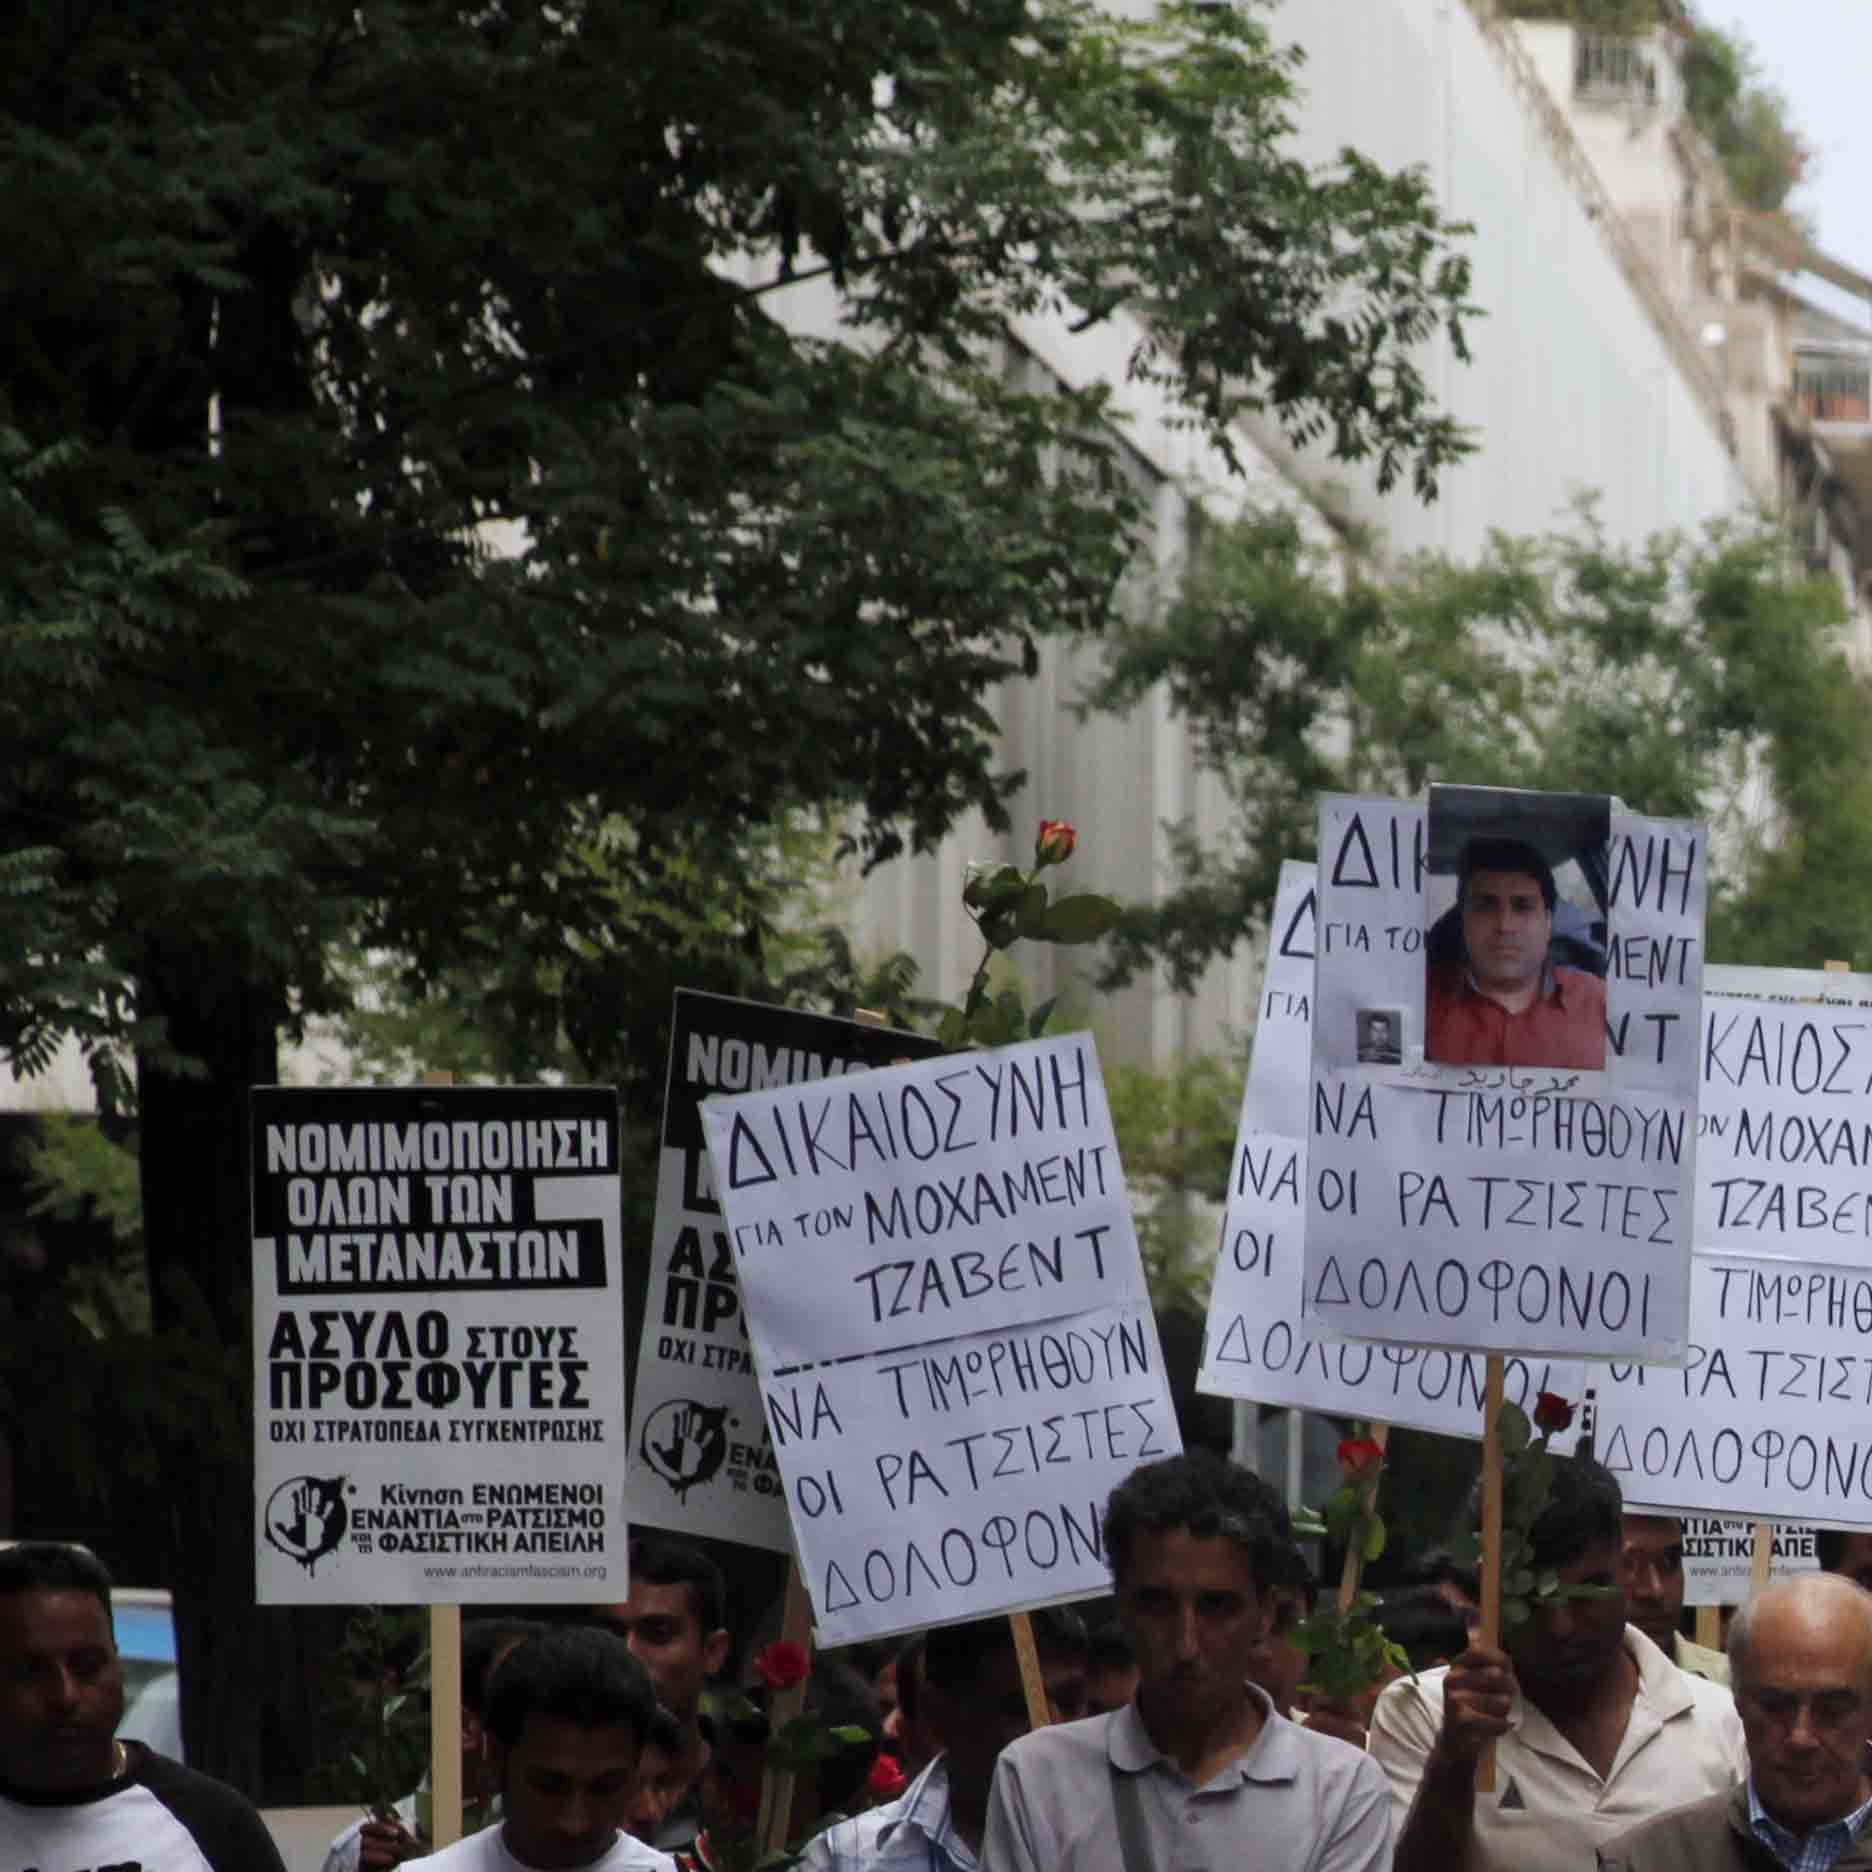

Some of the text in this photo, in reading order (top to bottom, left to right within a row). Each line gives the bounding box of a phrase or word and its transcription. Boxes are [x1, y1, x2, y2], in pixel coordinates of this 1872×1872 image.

[1324, 923, 1426, 953] ΓΙΑ ΤΟ
[1266, 991, 1310, 1020] ΓΙΑ
[729, 1047, 1088, 1188] ΔΙΚΑΙΟΣΥΝΗ
[1315, 1081, 1686, 1165] ΝΑ ΤΙΜΩΡΗΘΟΥΝ
[267, 1119, 608, 1174] ΝΟΜΙΜΟΠΟΙΗΣΗ
[735, 1220, 784, 1255] ΓΙΑ
[794, 1204, 854, 1239] ΤΟΝ
[865, 1145, 1108, 1244] ΜΟΧΑΜΕΝΤ
[1239, 1144, 1299, 1205] ΝΑ
[288, 1175, 512, 1226] ΟΛΩΝ ΤΩΝ
[1318, 1168, 1679, 1245] ΟΙ ΡΑΤΣΙΣΤΕΣ
[288, 1231, 579, 1282] ΜΕΤΑΝΑΣΤΩΝ
[854, 1225, 1111, 1322] ΤΖΑΒΕΝΤ
[1233, 1229, 1274, 1276] ΟΙ
[1314, 1255, 1650, 1337] ΔΟΛΟΦΟΝΟΙ
[269, 1310, 578, 1359] ΑΣΥΛΟ ΣΤΟΥΣ
[658, 1336, 696, 1367] ΟΧΙ
[270, 1361, 589, 1410] ΠΡΟΣΦΥΓΕΣ
[767, 1319, 1150, 1446] ΝΑ ΤΙΜΩΡΗΘΟΥΝ
[270, 1419, 604, 1442] ΟΧΙ ΣΤΡΑΤΟΠΕΔΑ ΣΥΓΚΕΝΤΡΩΣΗΣ
[797, 1470, 843, 1518] ΟΙ
[876, 1399, 1165, 1510] ΡΑΤΣΙΣΤΕΣ
[352, 1508, 605, 1530] ΕΝΑΝΤΙΑ στο ΡΑΤΣΙΣΜΟ
[381, 1484, 603, 1505] Κίνηση ΕΝΩΜΕΝΟΙ
[379, 1532, 507, 1552] ΦΑΣΙΣΤΙΚΗ
[516, 1532, 604, 1552] ΑΠΕΙΛΗ
[825, 1502, 1101, 1613] ΔΟΛΟΦΟΝ
[1770, 1538, 1813, 1558] ΑΠΕ
